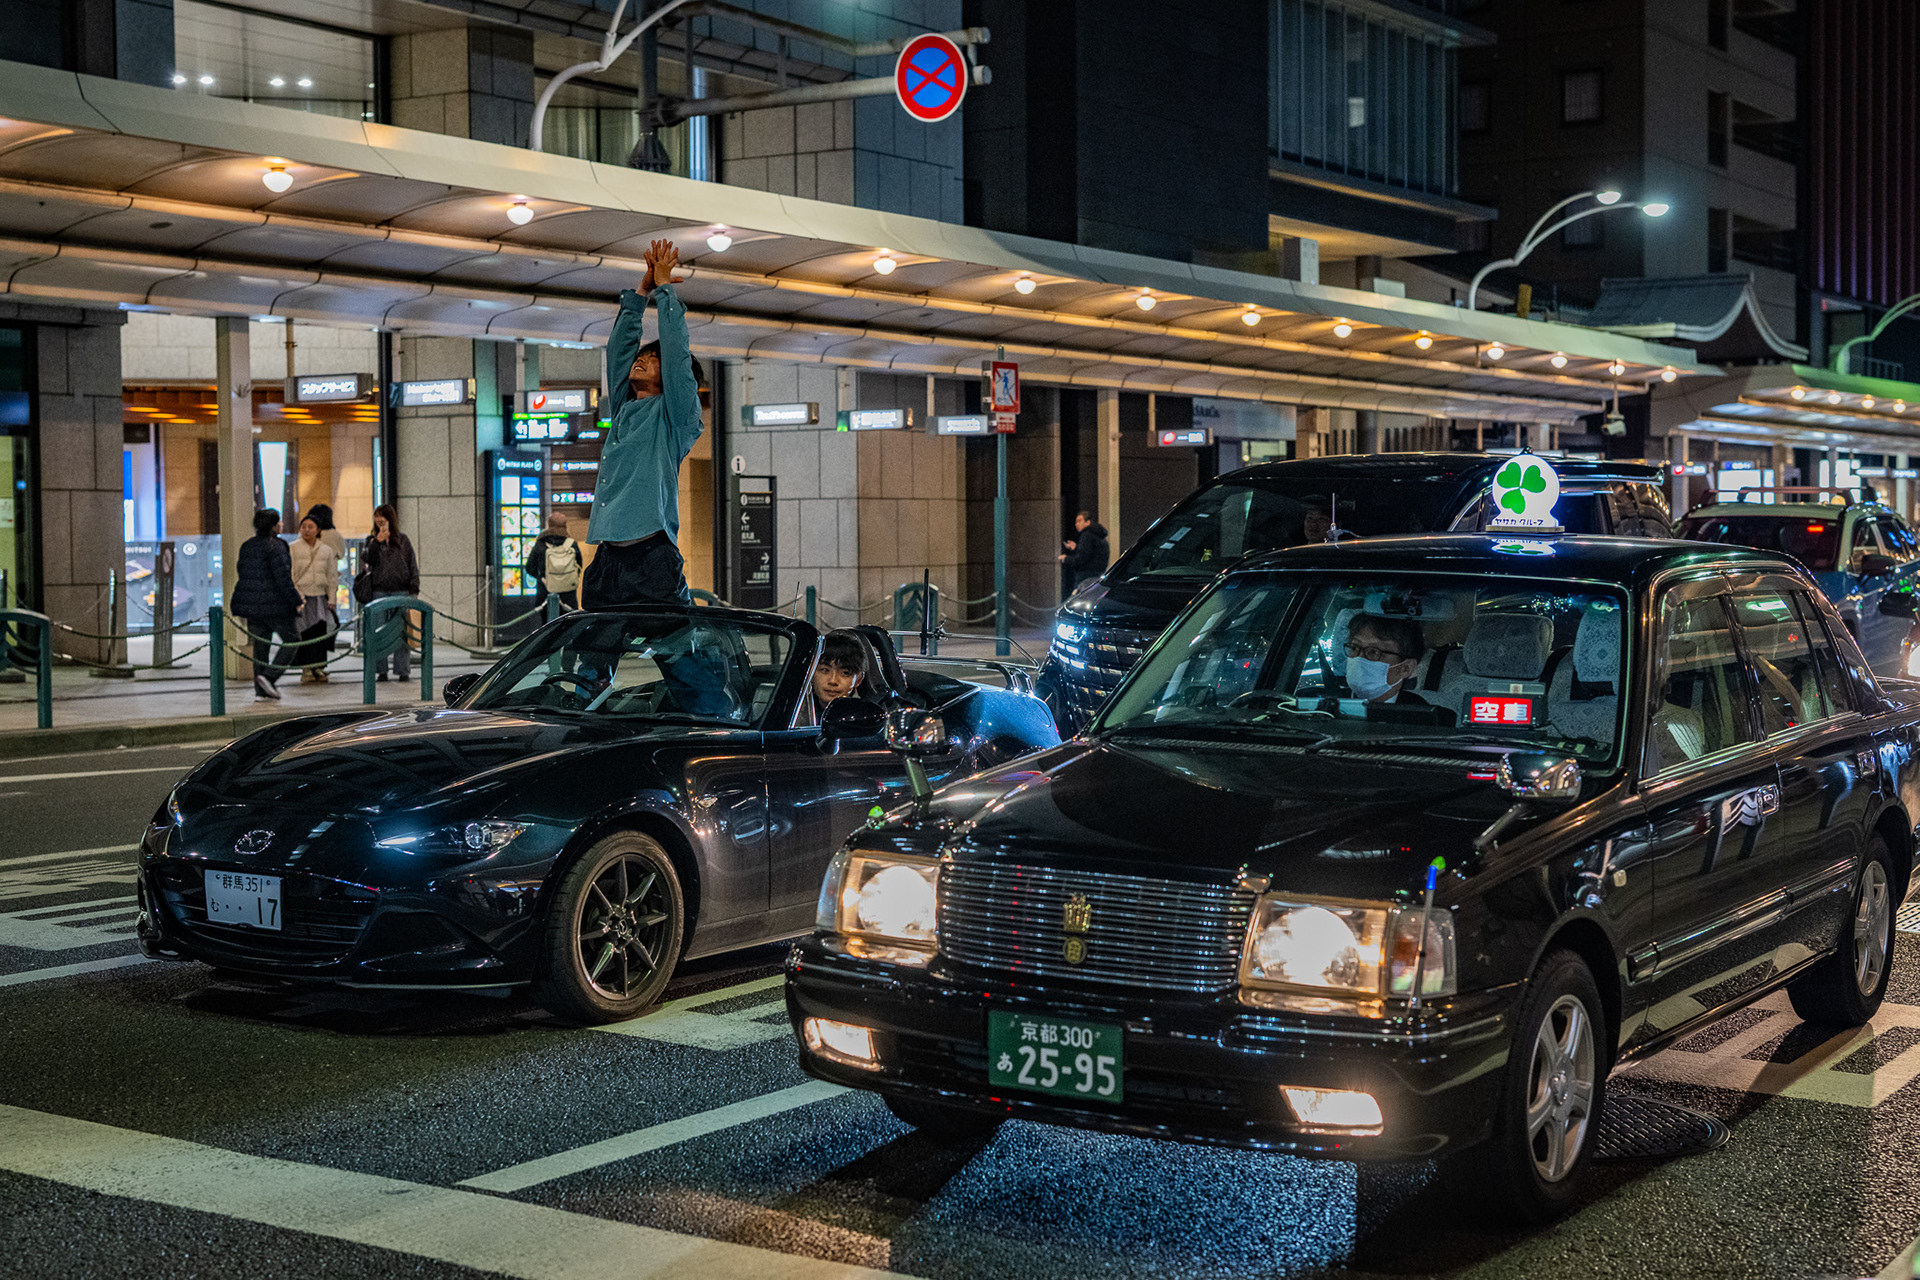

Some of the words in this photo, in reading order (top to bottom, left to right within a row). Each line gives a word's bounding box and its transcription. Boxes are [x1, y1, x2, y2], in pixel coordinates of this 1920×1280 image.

[1474, 701, 1528, 722] 空車
[211, 897, 220, 912] む
[997, 1052, 1013, 1073] あ
[1017, 1045, 1116, 1096] 25-95
